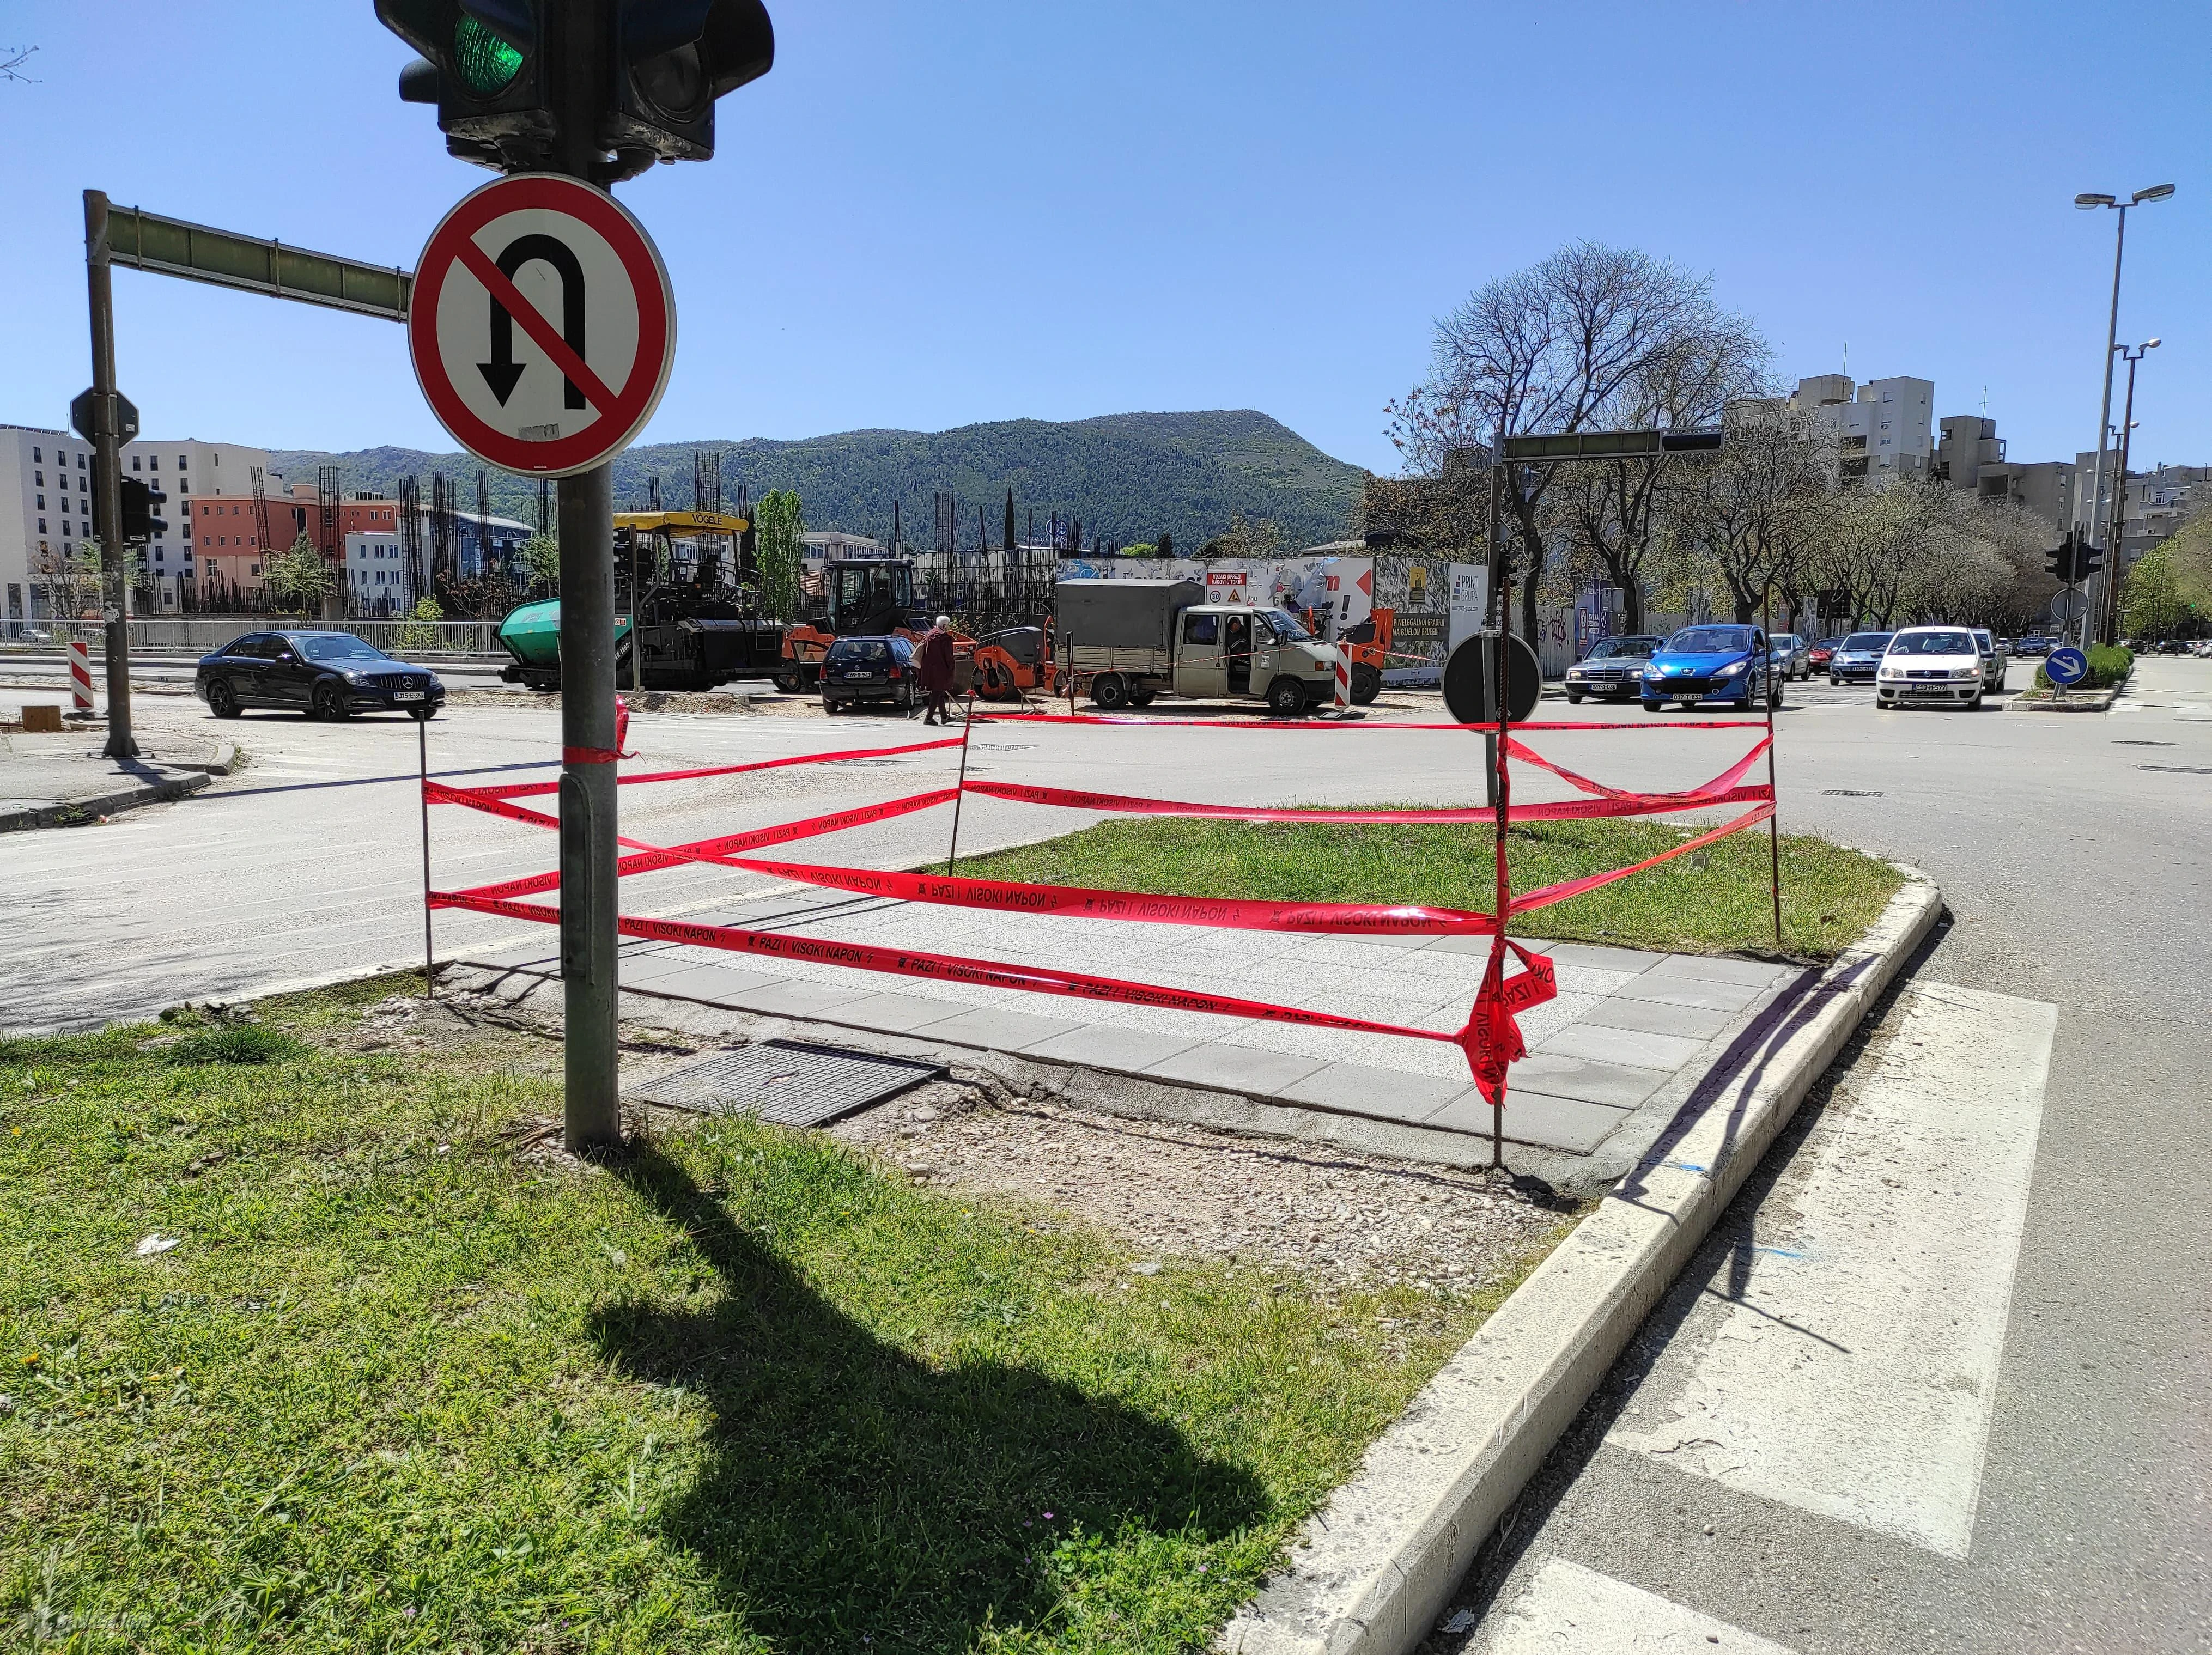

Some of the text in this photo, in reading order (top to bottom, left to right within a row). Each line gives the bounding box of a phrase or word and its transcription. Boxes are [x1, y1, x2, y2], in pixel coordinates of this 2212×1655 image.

[692, 513, 722, 525] VÖGELE
[1461, 575, 1478, 589] PRINT
[1461, 589, 1478, 601] GRUPA
[1397, 618, 1427, 626] NELEGALNOJ
[1427, 618, 1445, 626] GRADNJI
[1393, 628, 1401, 636] NA
[1401, 628, 1421, 636] BIJELOM
[653, 923, 682, 938] VISOKI
[684, 926, 717, 942] NAPON
[792, 940, 825, 958] VISOKI
[825, 946, 864, 963] NAPON
